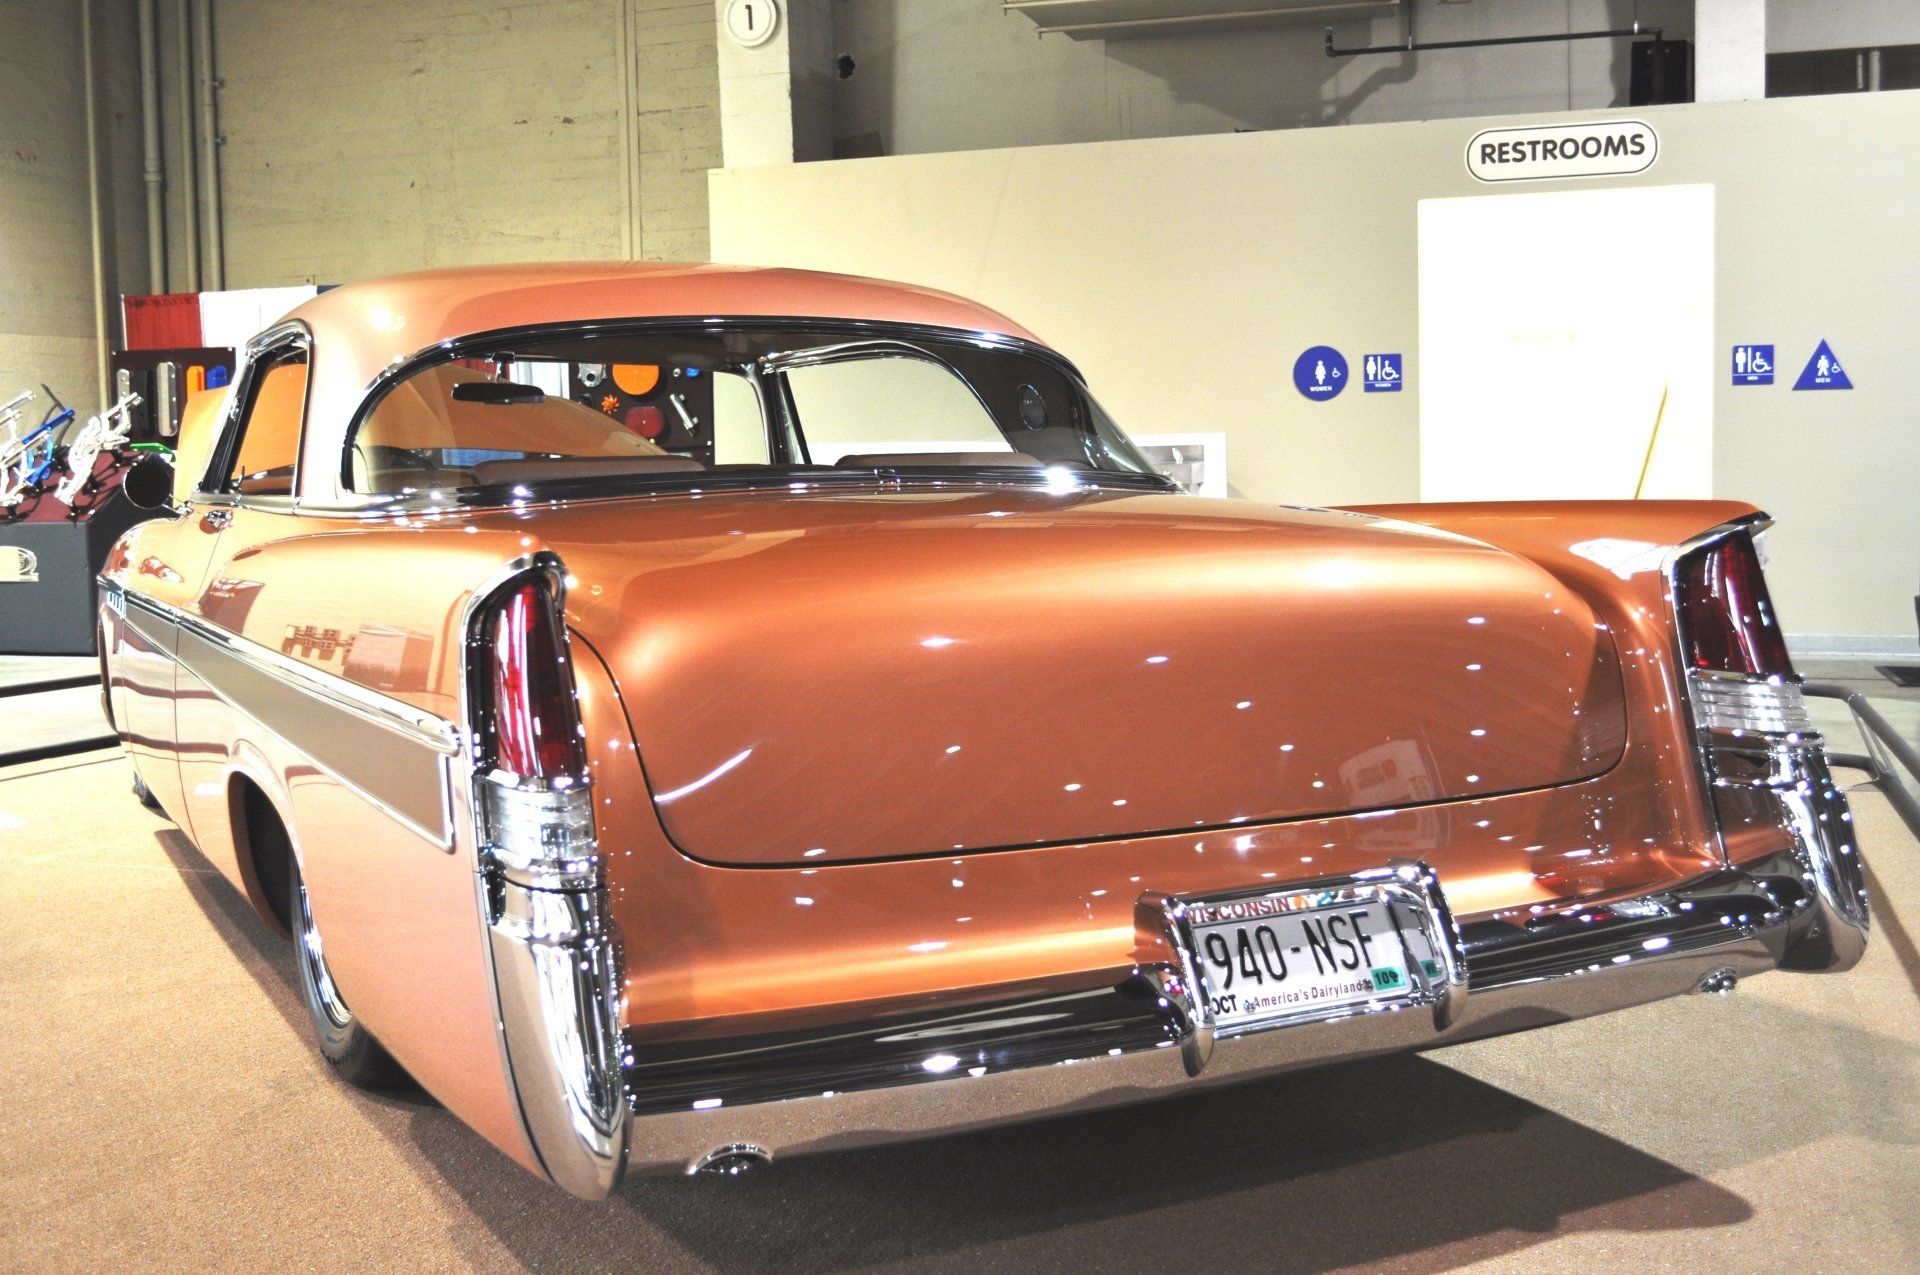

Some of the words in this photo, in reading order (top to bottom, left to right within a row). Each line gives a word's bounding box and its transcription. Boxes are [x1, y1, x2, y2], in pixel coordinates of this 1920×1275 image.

[745, 4, 753, 31] 1
[1480, 133, 1646, 165] RESTROOMS
[1204, 909, 1373, 990] 940-NSF
[1254, 988, 1310, 1008] America's
[1310, 979, 1364, 999] Dairyland
